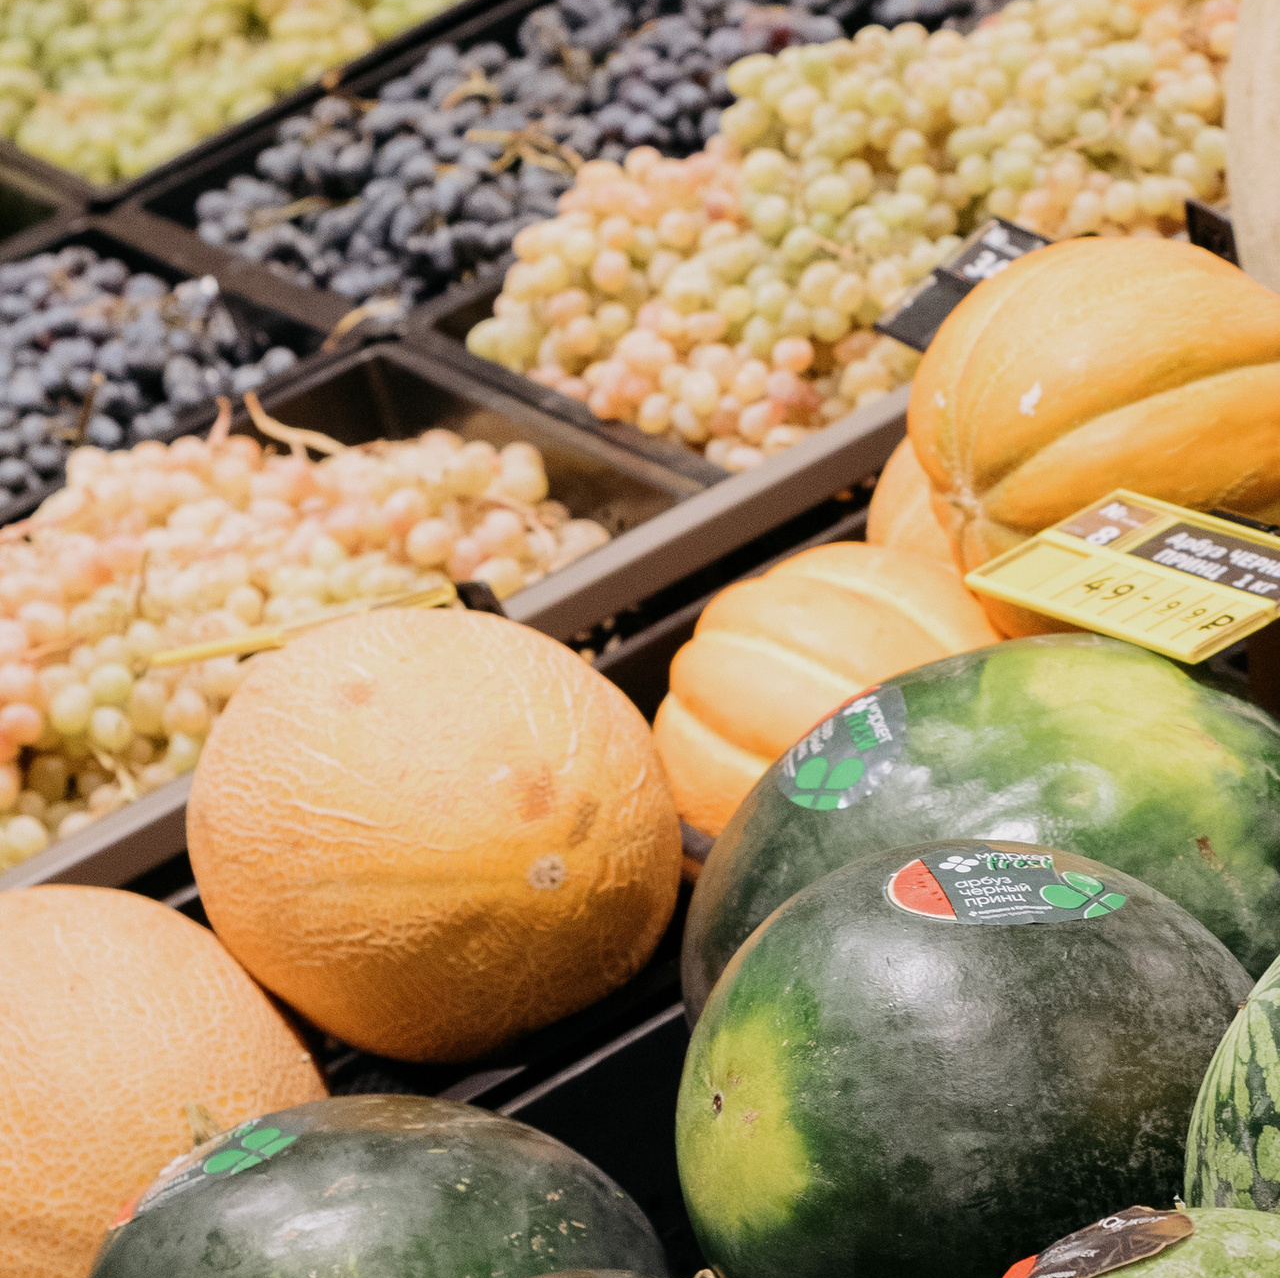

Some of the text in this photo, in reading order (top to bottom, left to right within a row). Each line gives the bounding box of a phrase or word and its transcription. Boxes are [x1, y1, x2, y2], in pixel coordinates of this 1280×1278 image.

[1086, 525, 1121, 546] 8
[1164, 530, 1229, 560] Арбуз
[1152, 547, 1230, 582] ПРИНЦ
[954, 876, 1013, 889] арбуз
[959, 883, 1032, 897] черный
[964, 894, 1027, 908] принц
